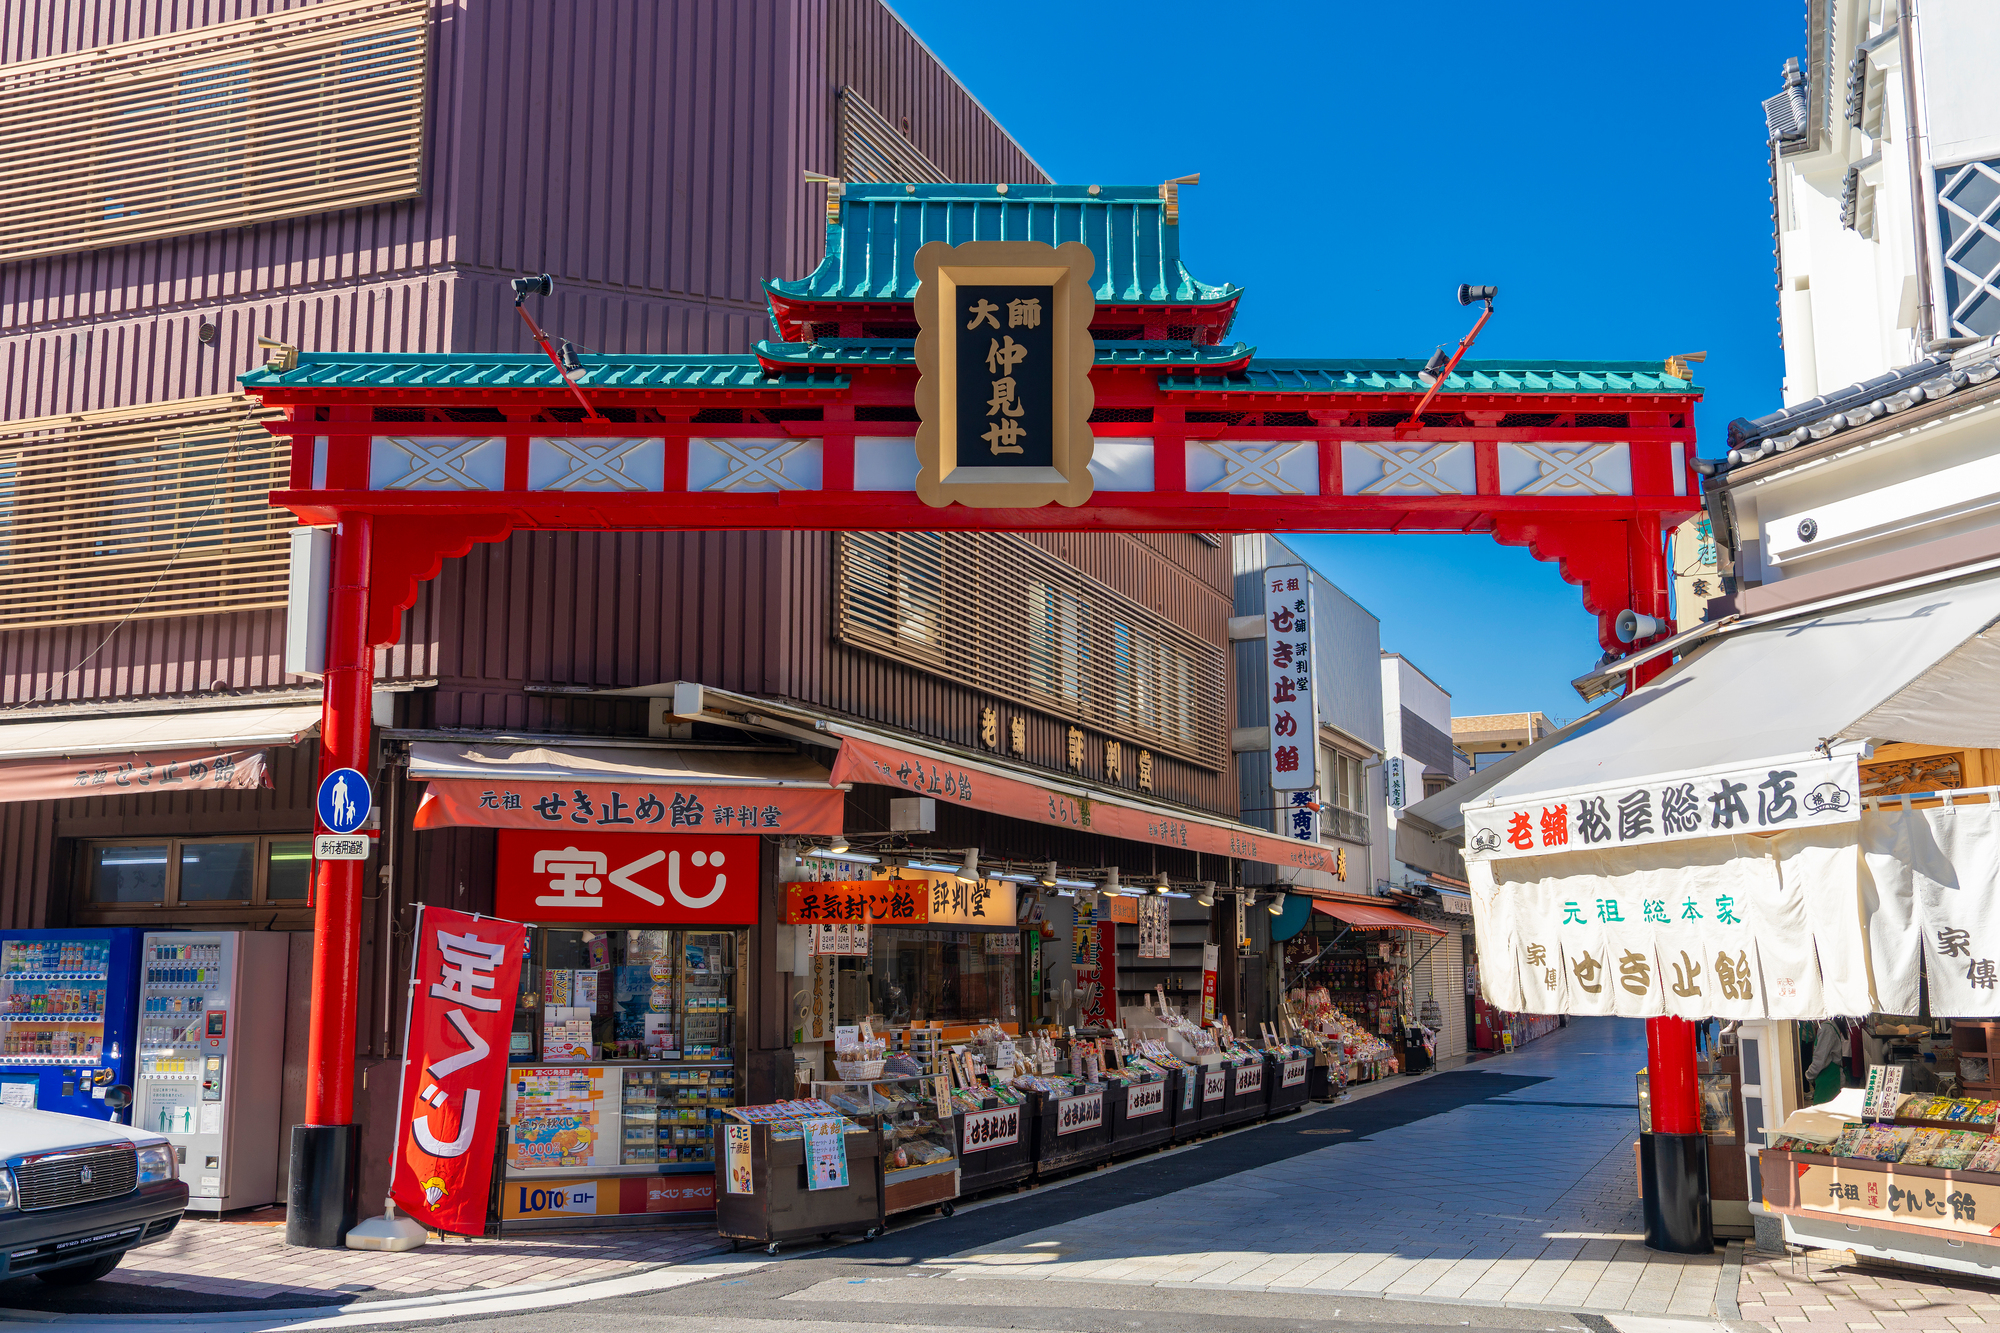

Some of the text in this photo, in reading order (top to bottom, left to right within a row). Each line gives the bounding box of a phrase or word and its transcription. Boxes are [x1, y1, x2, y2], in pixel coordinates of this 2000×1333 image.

[966, 297, 1042, 331] 大師
[980, 335, 1028, 456] 仲見世
[1293, 598, 1309, 692] 老舗 評判堂
[1269, 605, 1299, 773] せき止め飴
[72, 755, 237, 787] 元祖 せき止め飴
[1067, 725, 1153, 791] 評判堂
[896, 760, 973, 801] せき止め飴
[479, 789, 783, 829] 元祖 せき止め飴 評判堂
[1506, 770, 1799, 850] 老舗 松屋総本店
[321, 840, 364, 855] 歩行者用道路
[1159, 819, 1188, 847] 評判堂
[533, 846, 727, 909] 宝くじ
[800, 892, 915, 920] 呆気封じ飴
[933, 879, 986, 918] 評判堂
[1562, 893, 1742, 926] 元祖 総本家
[1937, 926, 1999, 990] 家傳
[1570, 948, 1754, 1001] せき止飴
[1064, 1098, 1101, 1127] せき止め飴
[1133, 1088, 1161, 1108] せき止め飴
[729, 1126, 749, 1141] 七五三
[808, 1121, 841, 1137] 千歳飴
[970, 1112, 1017, 1145] せき止め飴
[730, 1142, 750, 1155] 千歳飴
[518, 1186, 564, 1214] LOTO
[573, 1193, 595, 1203] ロト
[650, 1186, 712, 1200] 宝くじ 宝くじ
[1828, 1182, 1860, 1201] 元祖
[1867, 1181, 1881, 1209] 開運
